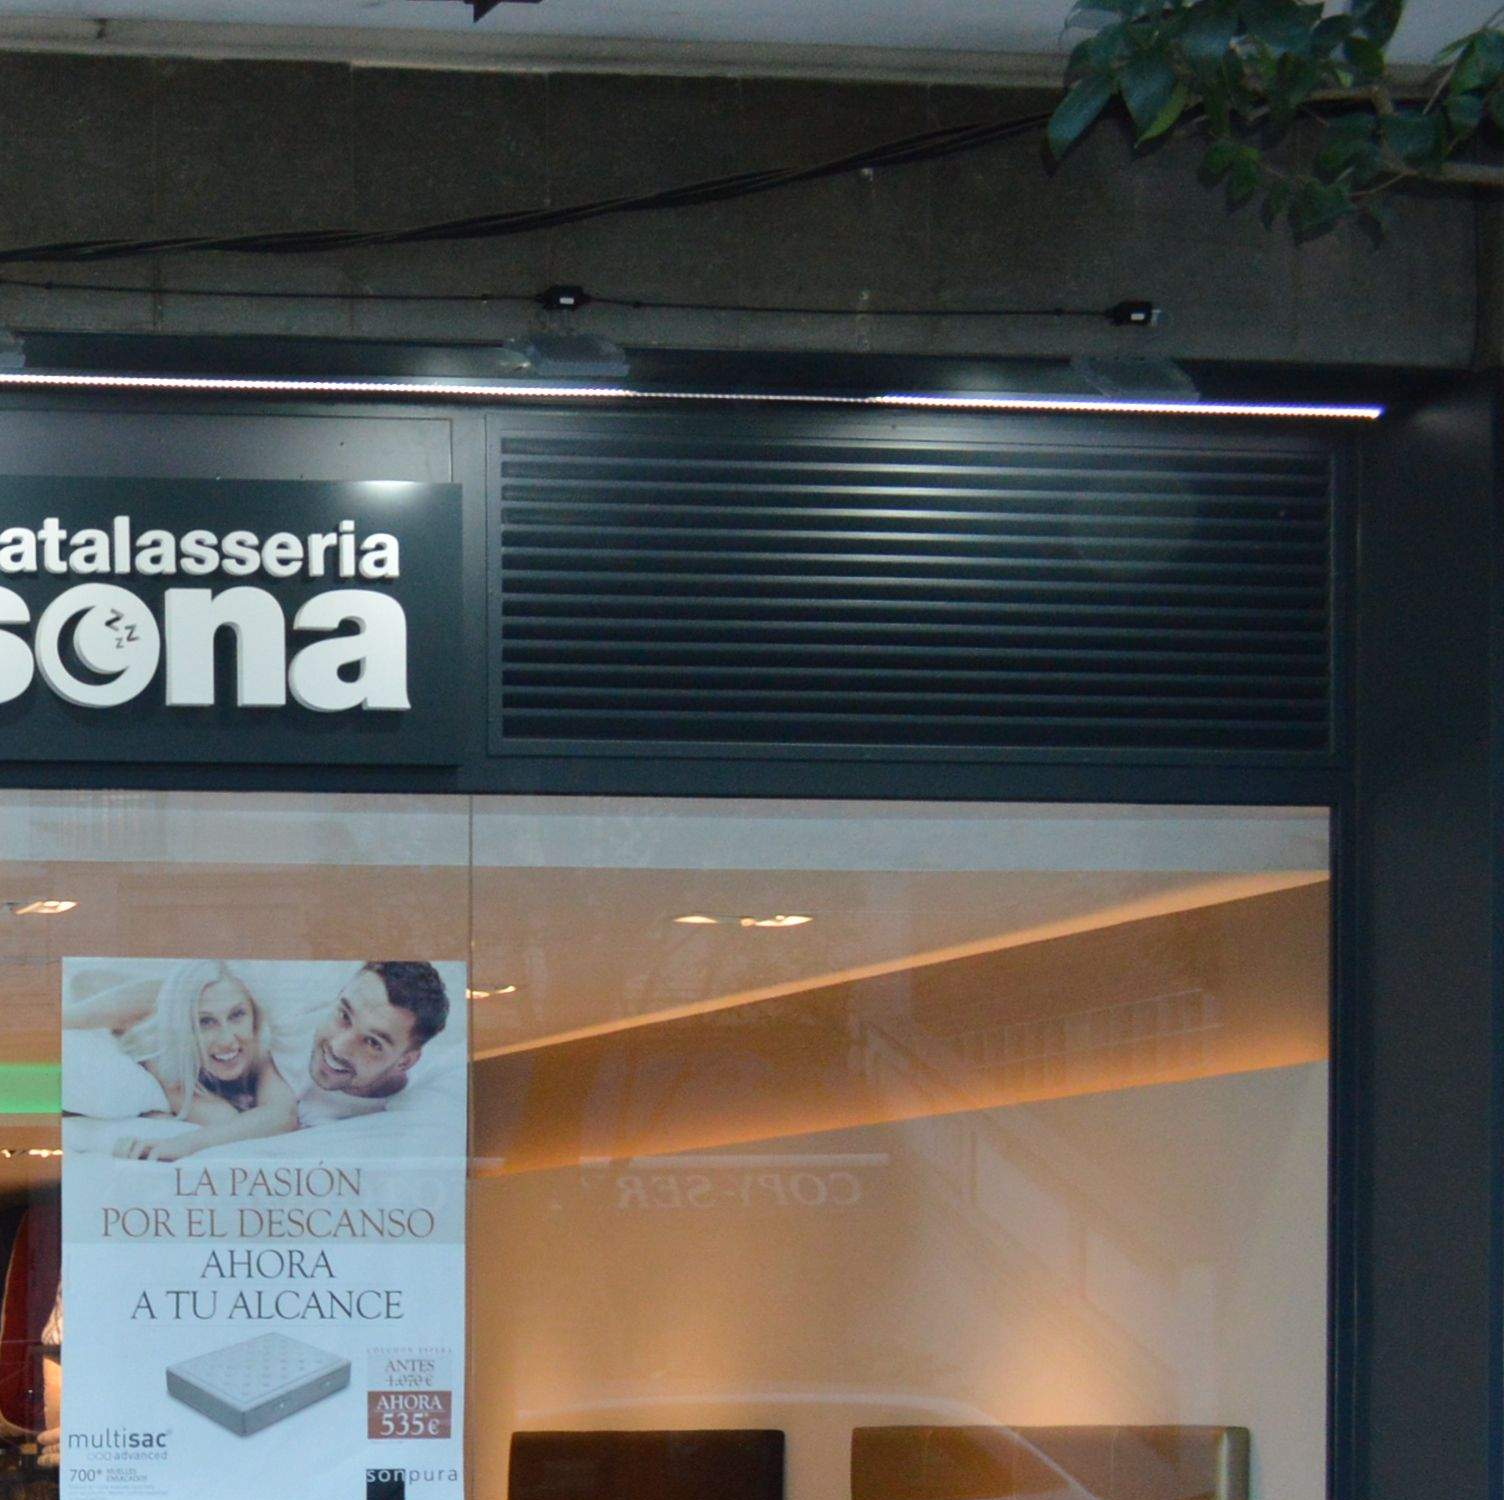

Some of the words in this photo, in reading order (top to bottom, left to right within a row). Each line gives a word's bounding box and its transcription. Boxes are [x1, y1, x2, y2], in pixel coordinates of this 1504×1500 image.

[175, 1167, 219, 1198] LA
[229, 1160, 363, 1198] PASIÓN
[101, 1207, 176, 1238] POR
[185, 1208, 228, 1238] EL
[238, 1208, 436, 1239] DESCANSO
[200, 1249, 337, 1280] AHORA
[130, 1290, 158, 1320] A
[166, 1290, 219, 1320] TU
[228, 1290, 404, 1320] ALCANCE
[385, 1359, 435, 1372] ANTES
[376, 1394, 443, 1410] AHORA
[379, 1412, 425, 1436] 535
[427, 1418, 441, 1435] €
[67, 1428, 168, 1449] multisac
[113, 1450, 168, 1461] advanced
[365, 1466, 458, 1485] sonpura
